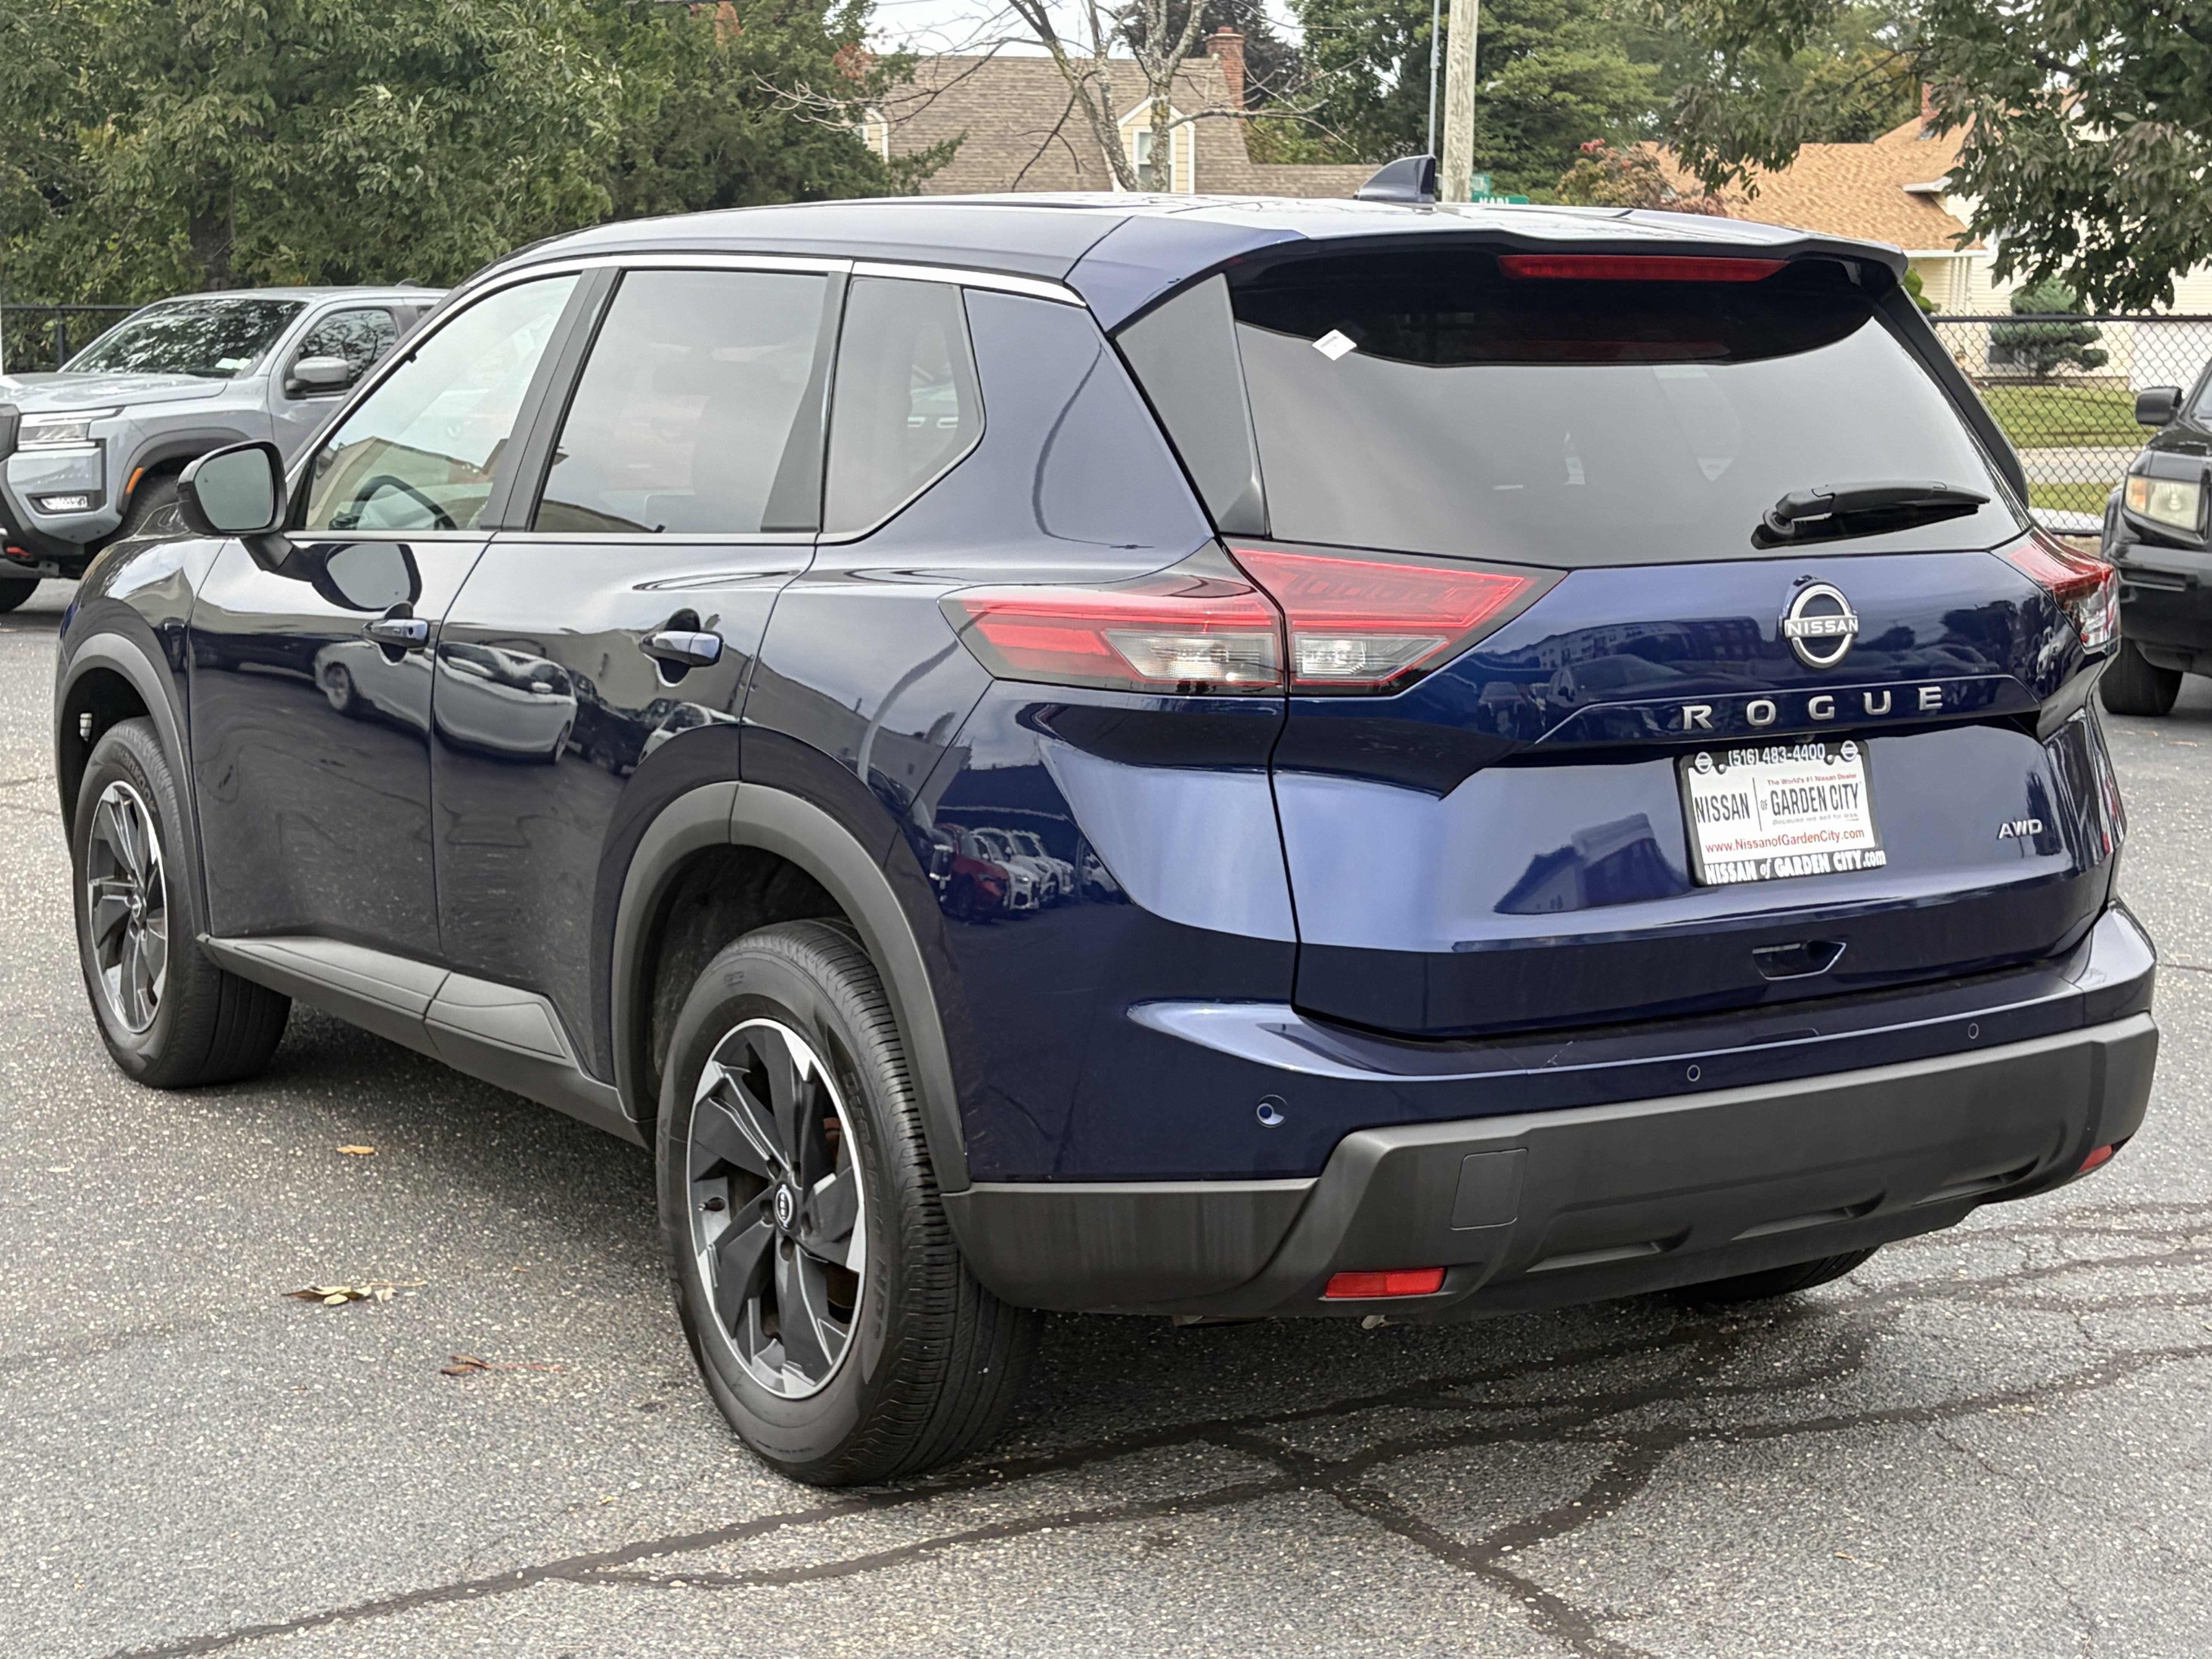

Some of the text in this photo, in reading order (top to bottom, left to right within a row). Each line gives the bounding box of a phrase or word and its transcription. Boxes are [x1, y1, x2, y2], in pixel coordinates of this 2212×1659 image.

[1787, 619, 1858, 636] NISSAN
[1682, 686, 1943, 730] ROGUE
[1728, 743, 1825, 767] (516) 483-4400
[1694, 782, 1858, 823] NISSAN OF GARDEN CITY
[1998, 818, 2043, 839] AWD
[1705, 829, 1865, 853] www.NissanofGardenCity.com
[1704, 860, 1758, 885] NISSAN
[1760, 857, 1772, 879] of
[1774, 853, 1831, 878] GARDEN
